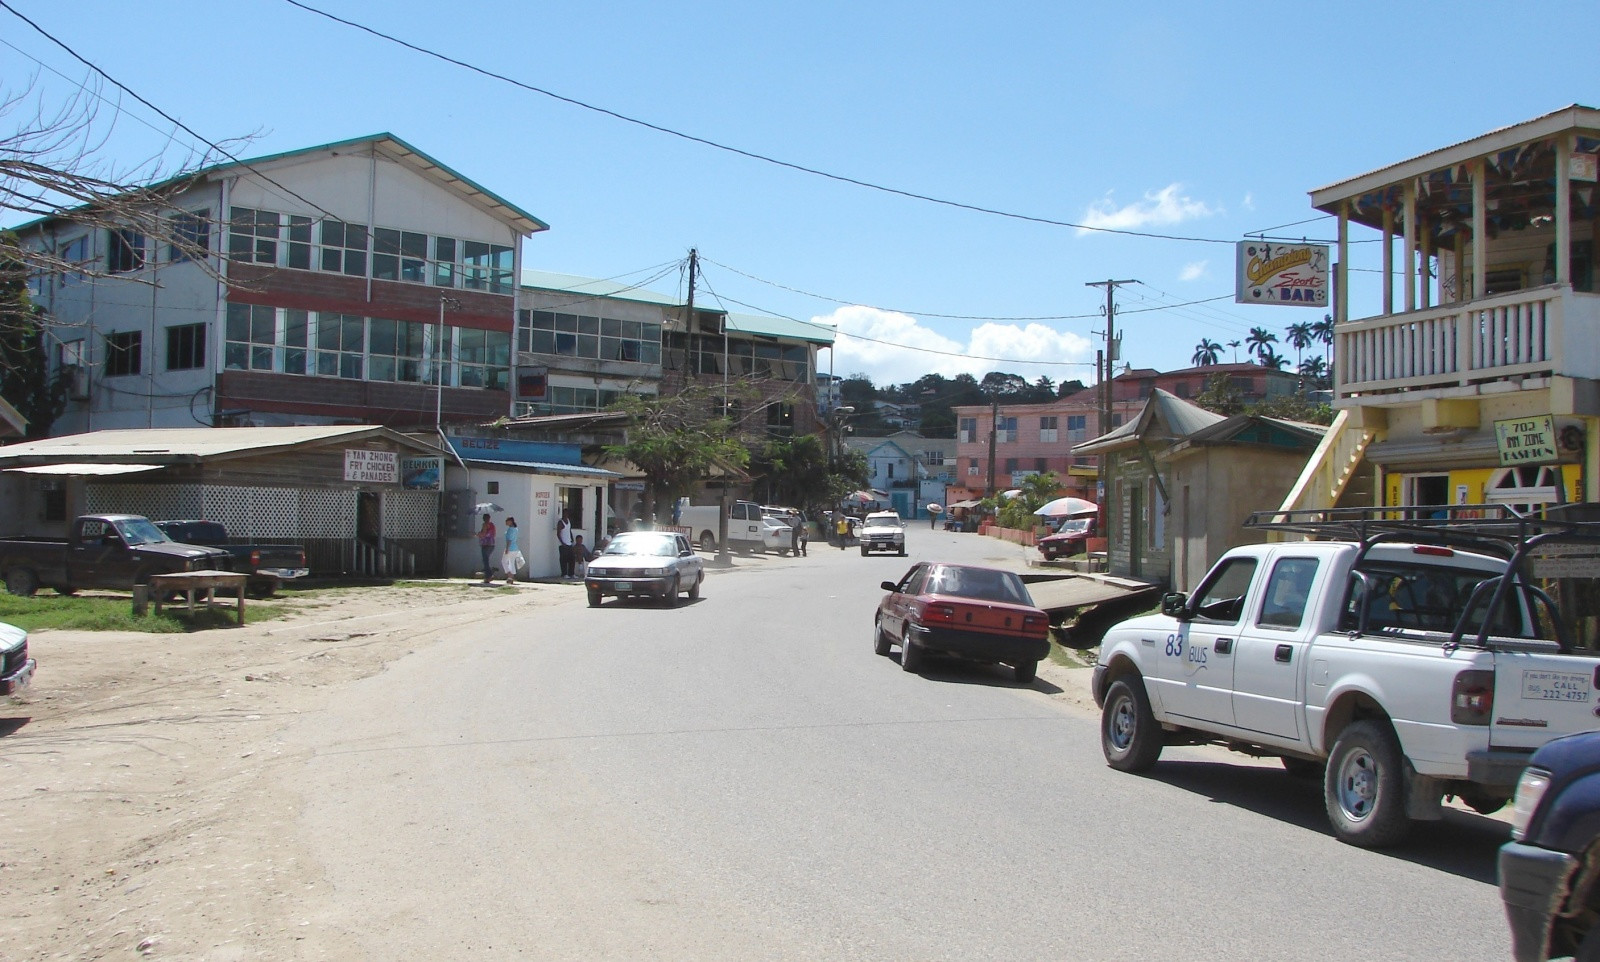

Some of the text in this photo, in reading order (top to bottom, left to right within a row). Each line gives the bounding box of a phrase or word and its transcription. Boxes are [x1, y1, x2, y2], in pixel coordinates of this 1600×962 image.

[1281, 288, 1316, 302] BAR
[1512, 422, 1535, 432] 702
[462, 439, 500, 450] BELIZE
[1523, 432, 1545, 446] ZONE
[369, 451, 393, 462] ZHONG
[1503, 447, 1554, 461] FASHION
[349, 461, 395, 472] FRY CHICKEN
[403, 459, 439, 470] BELIKIN
[361, 471, 392, 481] PANADES
[1166, 634, 1183, 656] 83
[1554, 682, 1577, 690] CALL
[1543, 689, 1587, 700] 222-4757
